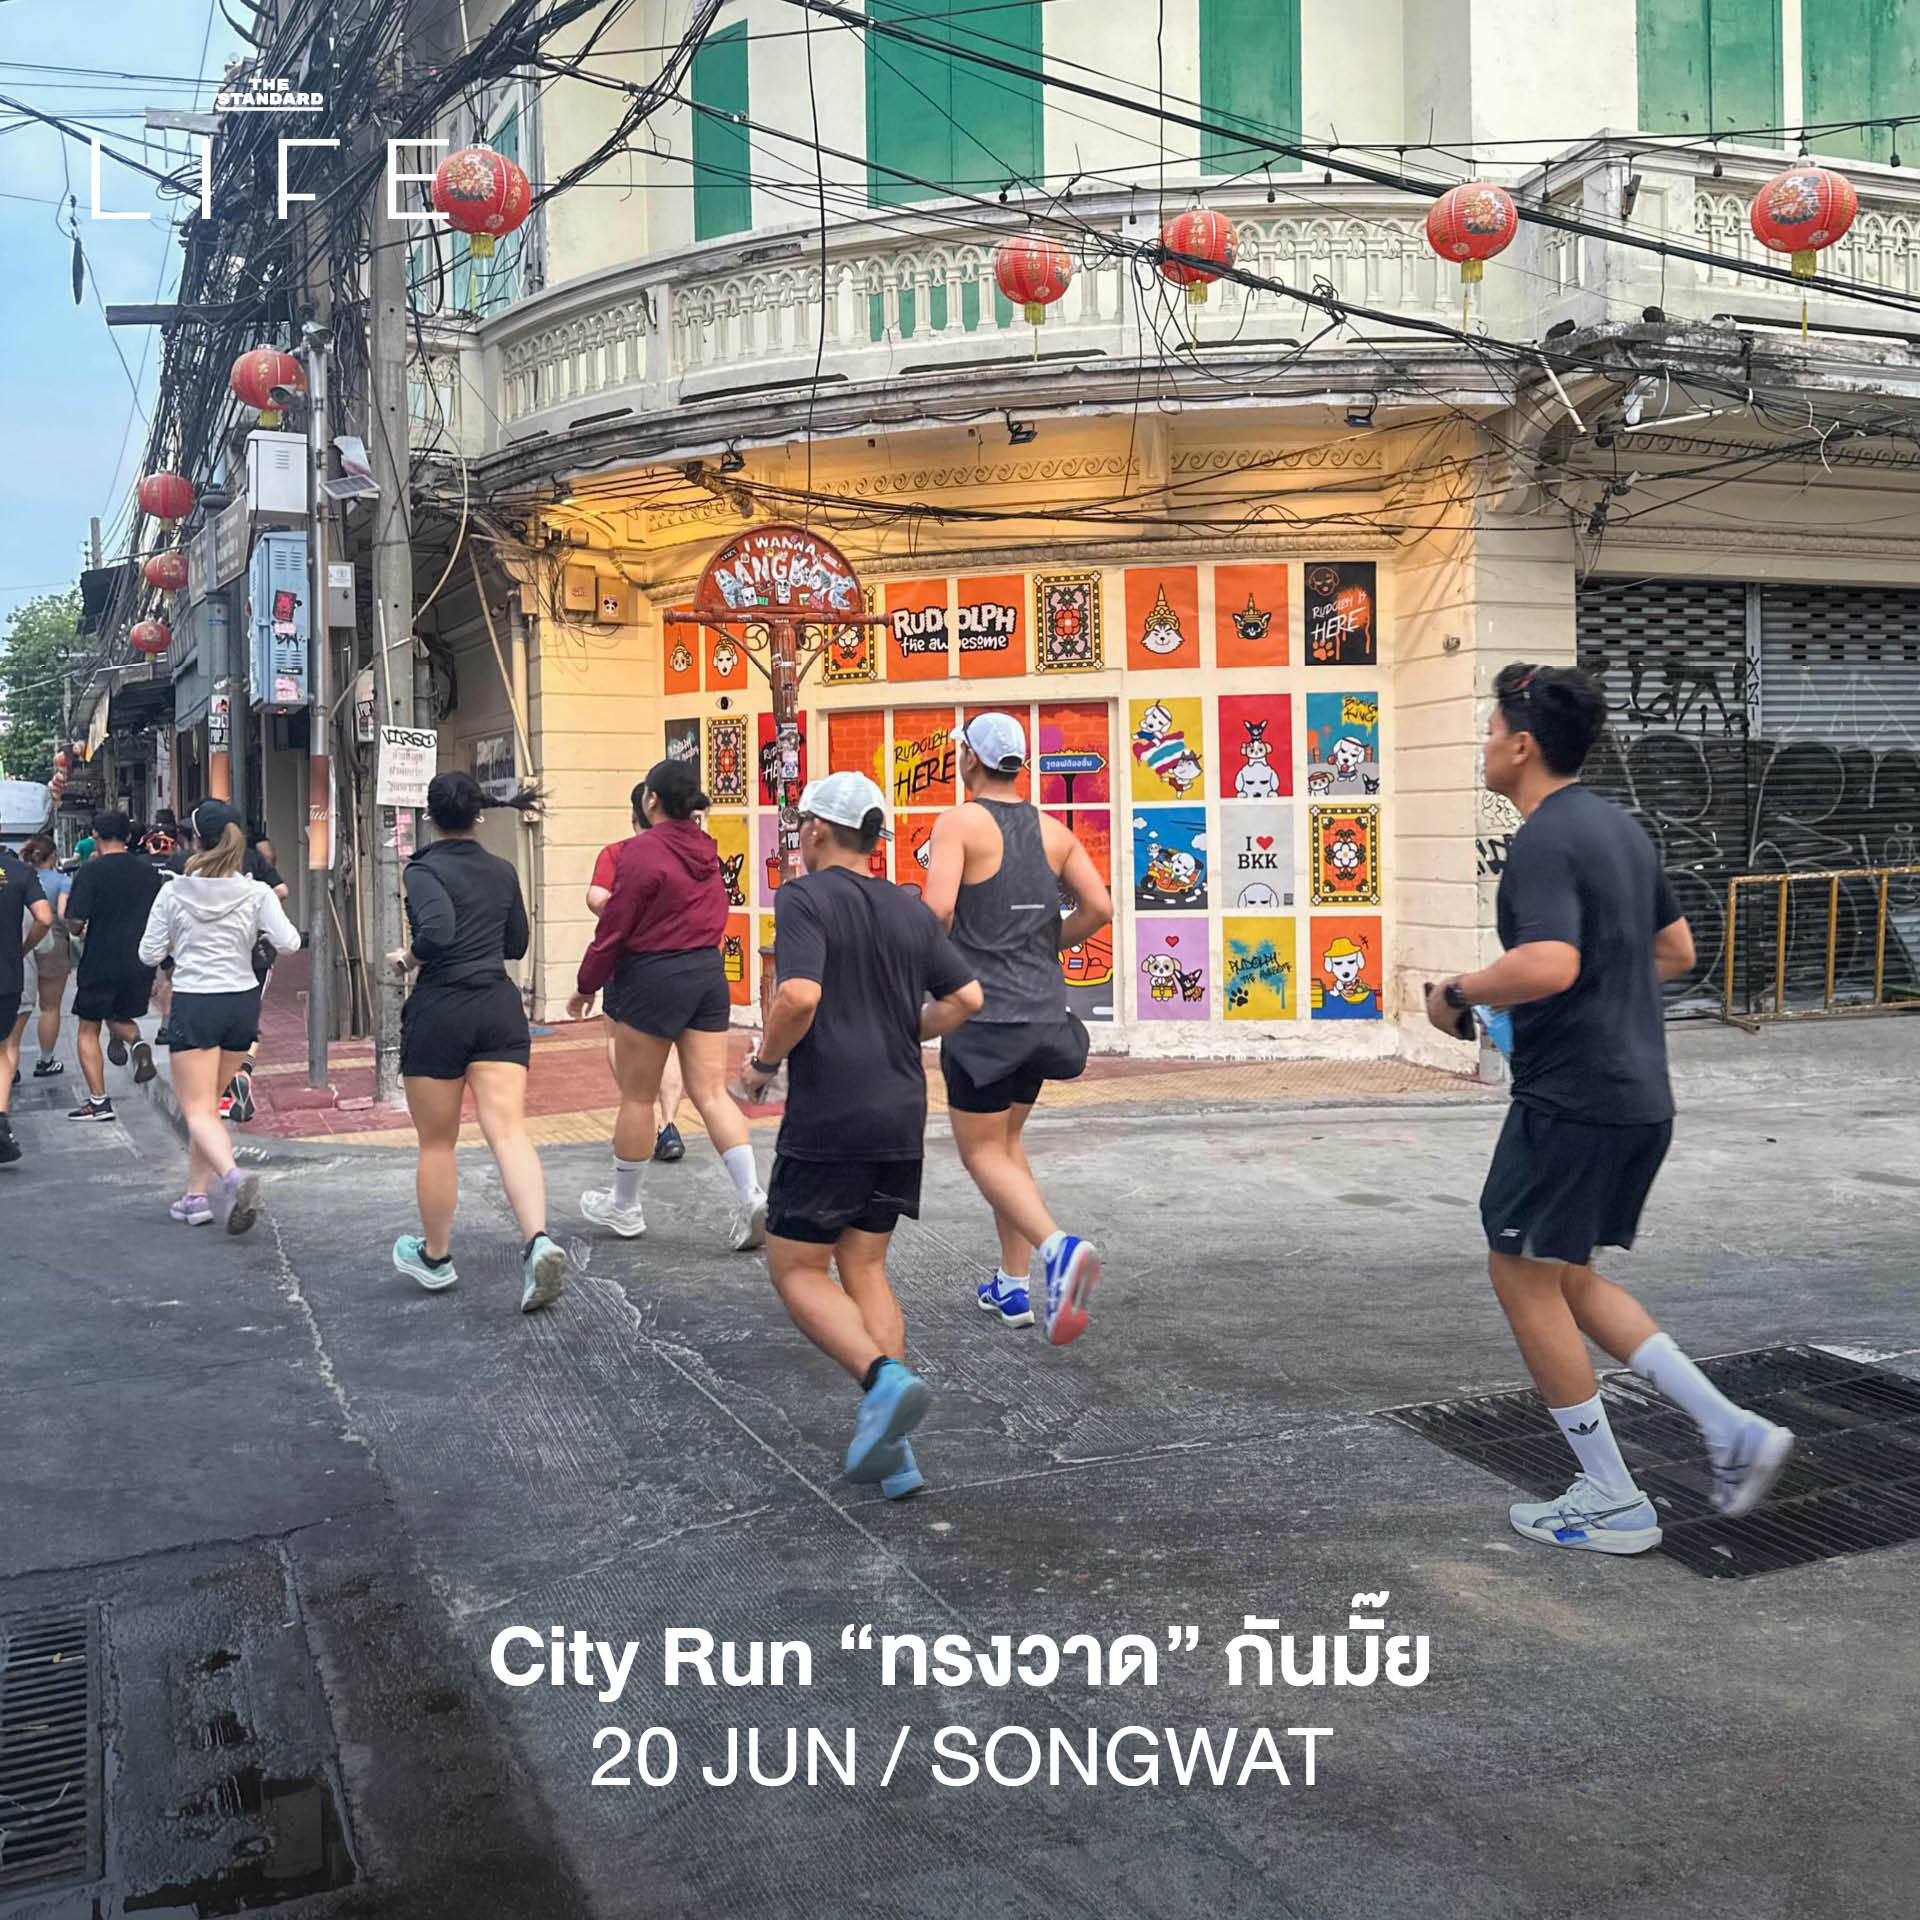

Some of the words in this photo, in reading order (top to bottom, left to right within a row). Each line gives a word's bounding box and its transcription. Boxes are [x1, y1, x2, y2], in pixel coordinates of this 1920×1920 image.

[755, 536, 817, 559] WANNA
[1312, 596, 1353, 619] RUDOLPH
[893, 603, 1016, 639] RUDOLPH
[1311, 606, 1367, 642] HERE
[901, 637, 925, 657] the
[894, 729, 949, 763] RUDOLPH
[894, 750, 955, 798] HERE
[1246, 836, 1252, 851] I
[1238, 854, 1278, 869] BKK
